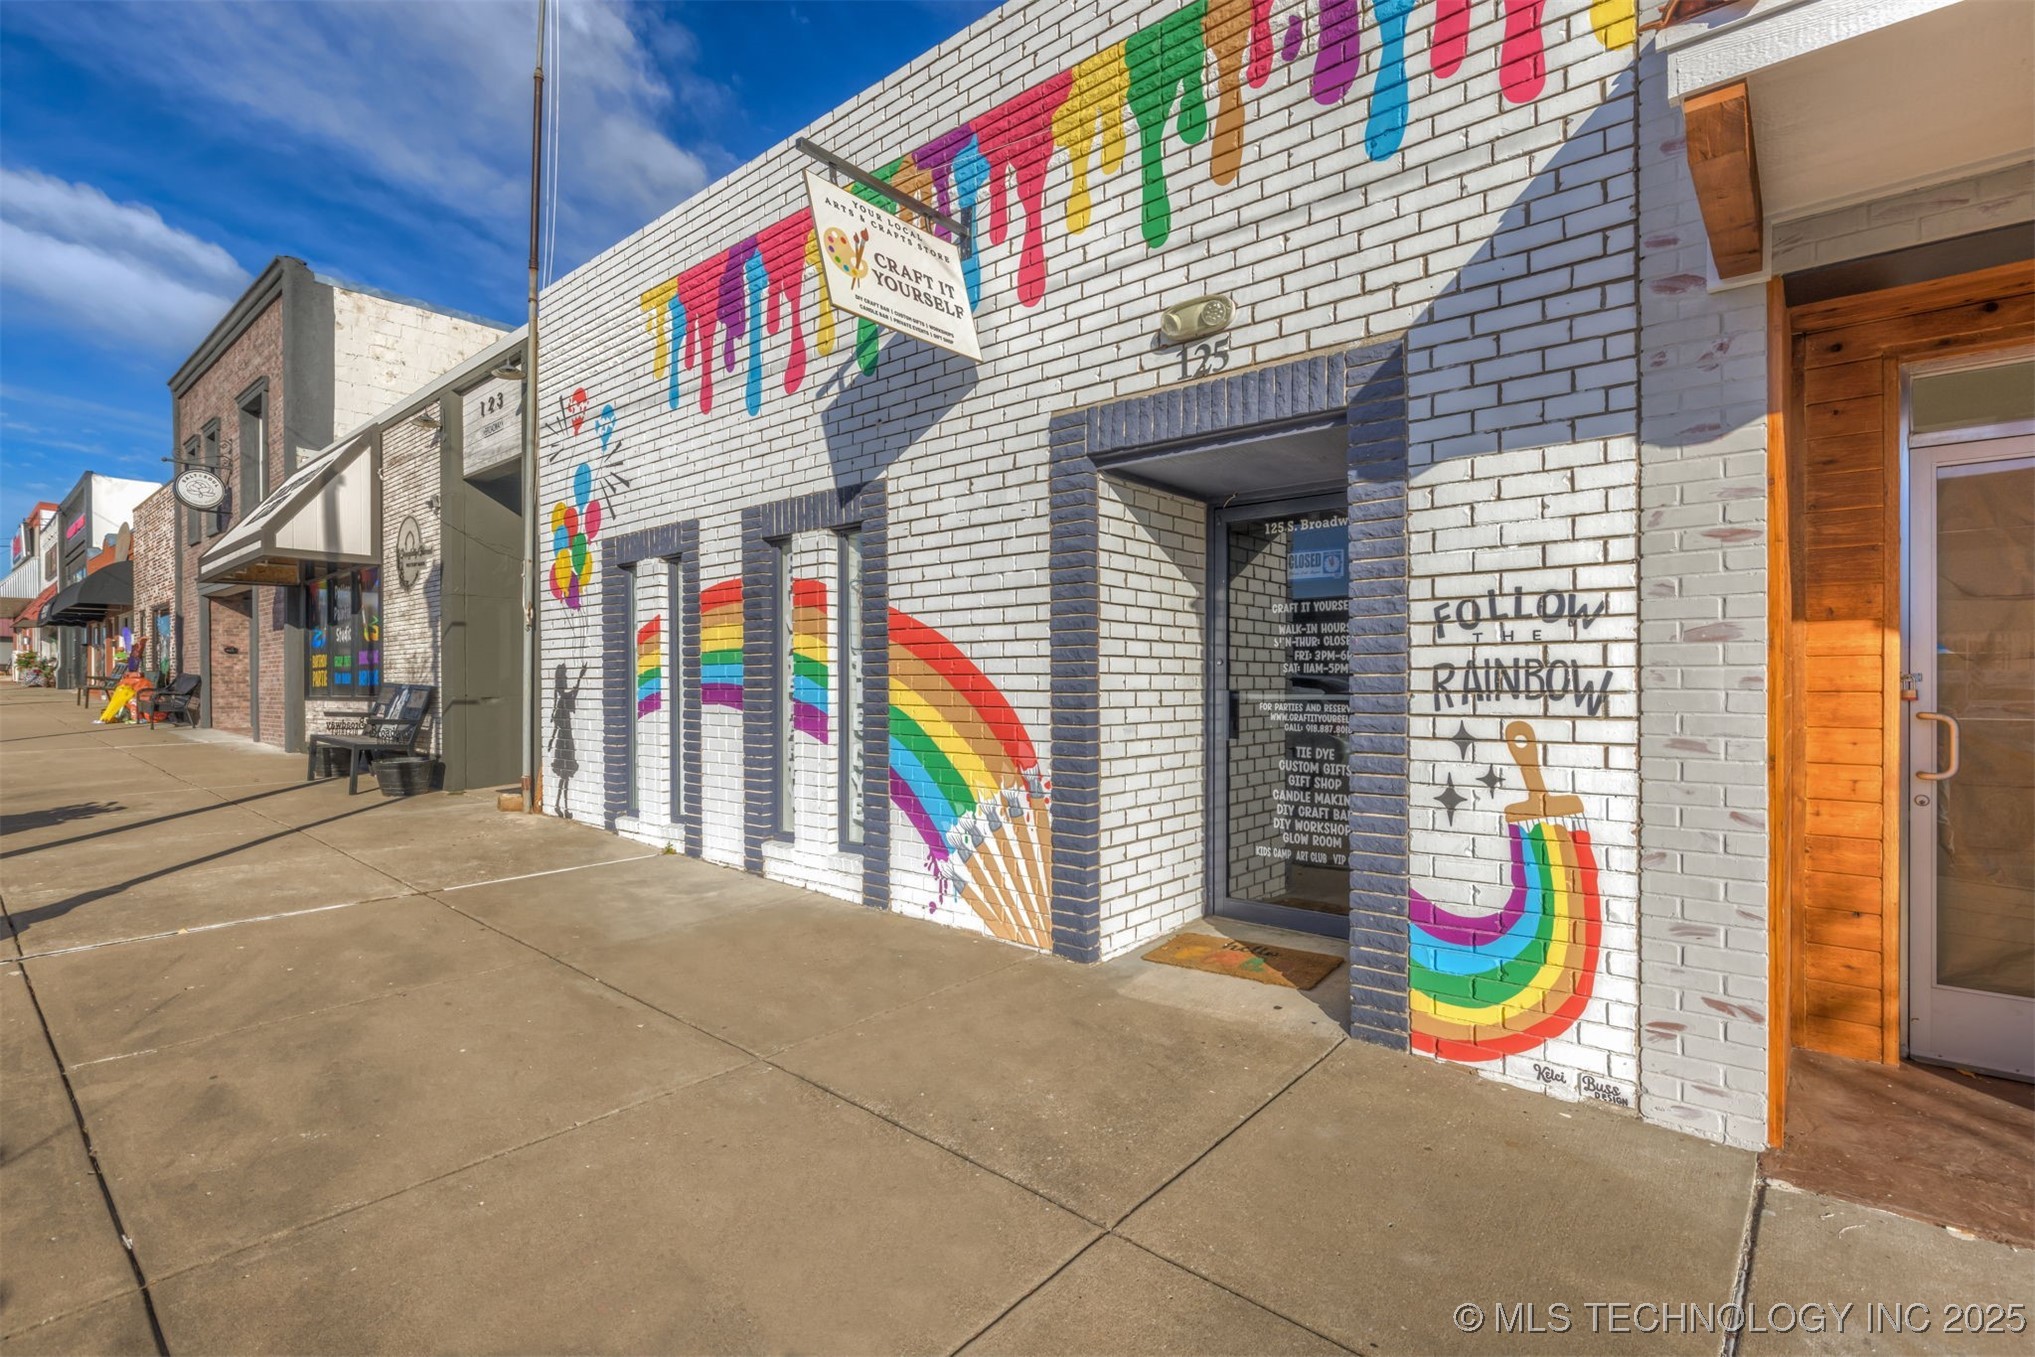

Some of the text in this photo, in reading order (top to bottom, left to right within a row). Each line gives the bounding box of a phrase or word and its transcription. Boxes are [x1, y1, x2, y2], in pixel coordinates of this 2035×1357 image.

[852, 200, 922, 241] YOUR LOCAL
[825, 197, 950, 264] ARTS & CRAFTS STORE
[874, 252, 955, 299] CRAFT IT
[871, 268, 964, 320] YOURSELF
[864, 298, 880, 308] CRAFT
[880, 304, 890, 313] BAR
[1176, 336, 1229, 380] 125
[480, 392, 504, 417] 123
[1265, 522, 1284, 535] 125
[1287, 520, 1297, 533] S.
[1288, 552, 1322, 570] CLOSED
[1272, 603, 1298, 614] CRAFT
[1301, 602, 1311, 613] IT
[1433, 586, 1605, 639] FOLLOW
[1278, 623, 1318, 635] WALK-IN
[1472, 630, 1542, 643] THE
[1294, 650, 1312, 661] FRI:
[1283, 662, 1300, 674] SAT:
[1433, 657, 1614, 716] RAINBOW
[1259, 702, 1272, 711] FOR
[1274, 702, 1303, 712] PARTIES
[1305, 703, 1322, 712] AND
[1284, 723, 1303, 732] CALL:
[1296, 746, 1335, 760] TIE DYE
[1279, 760, 1352, 777] CUSTOM GIFTS
[1288, 774, 1342, 790] GIFT SHOP
[1272, 789, 1311, 803] CANDLE
[1276, 803, 1295, 816] DIY
[1298, 805, 1330, 820] CRAFT
[1273, 817, 1291, 830] DIY
[1282, 832, 1342, 849] GLOW ROOM
[1255, 845, 1346, 865] KIDS CAMP ART CLUB VIP
[1533, 1063, 1621, 1096] Kelci Buss
